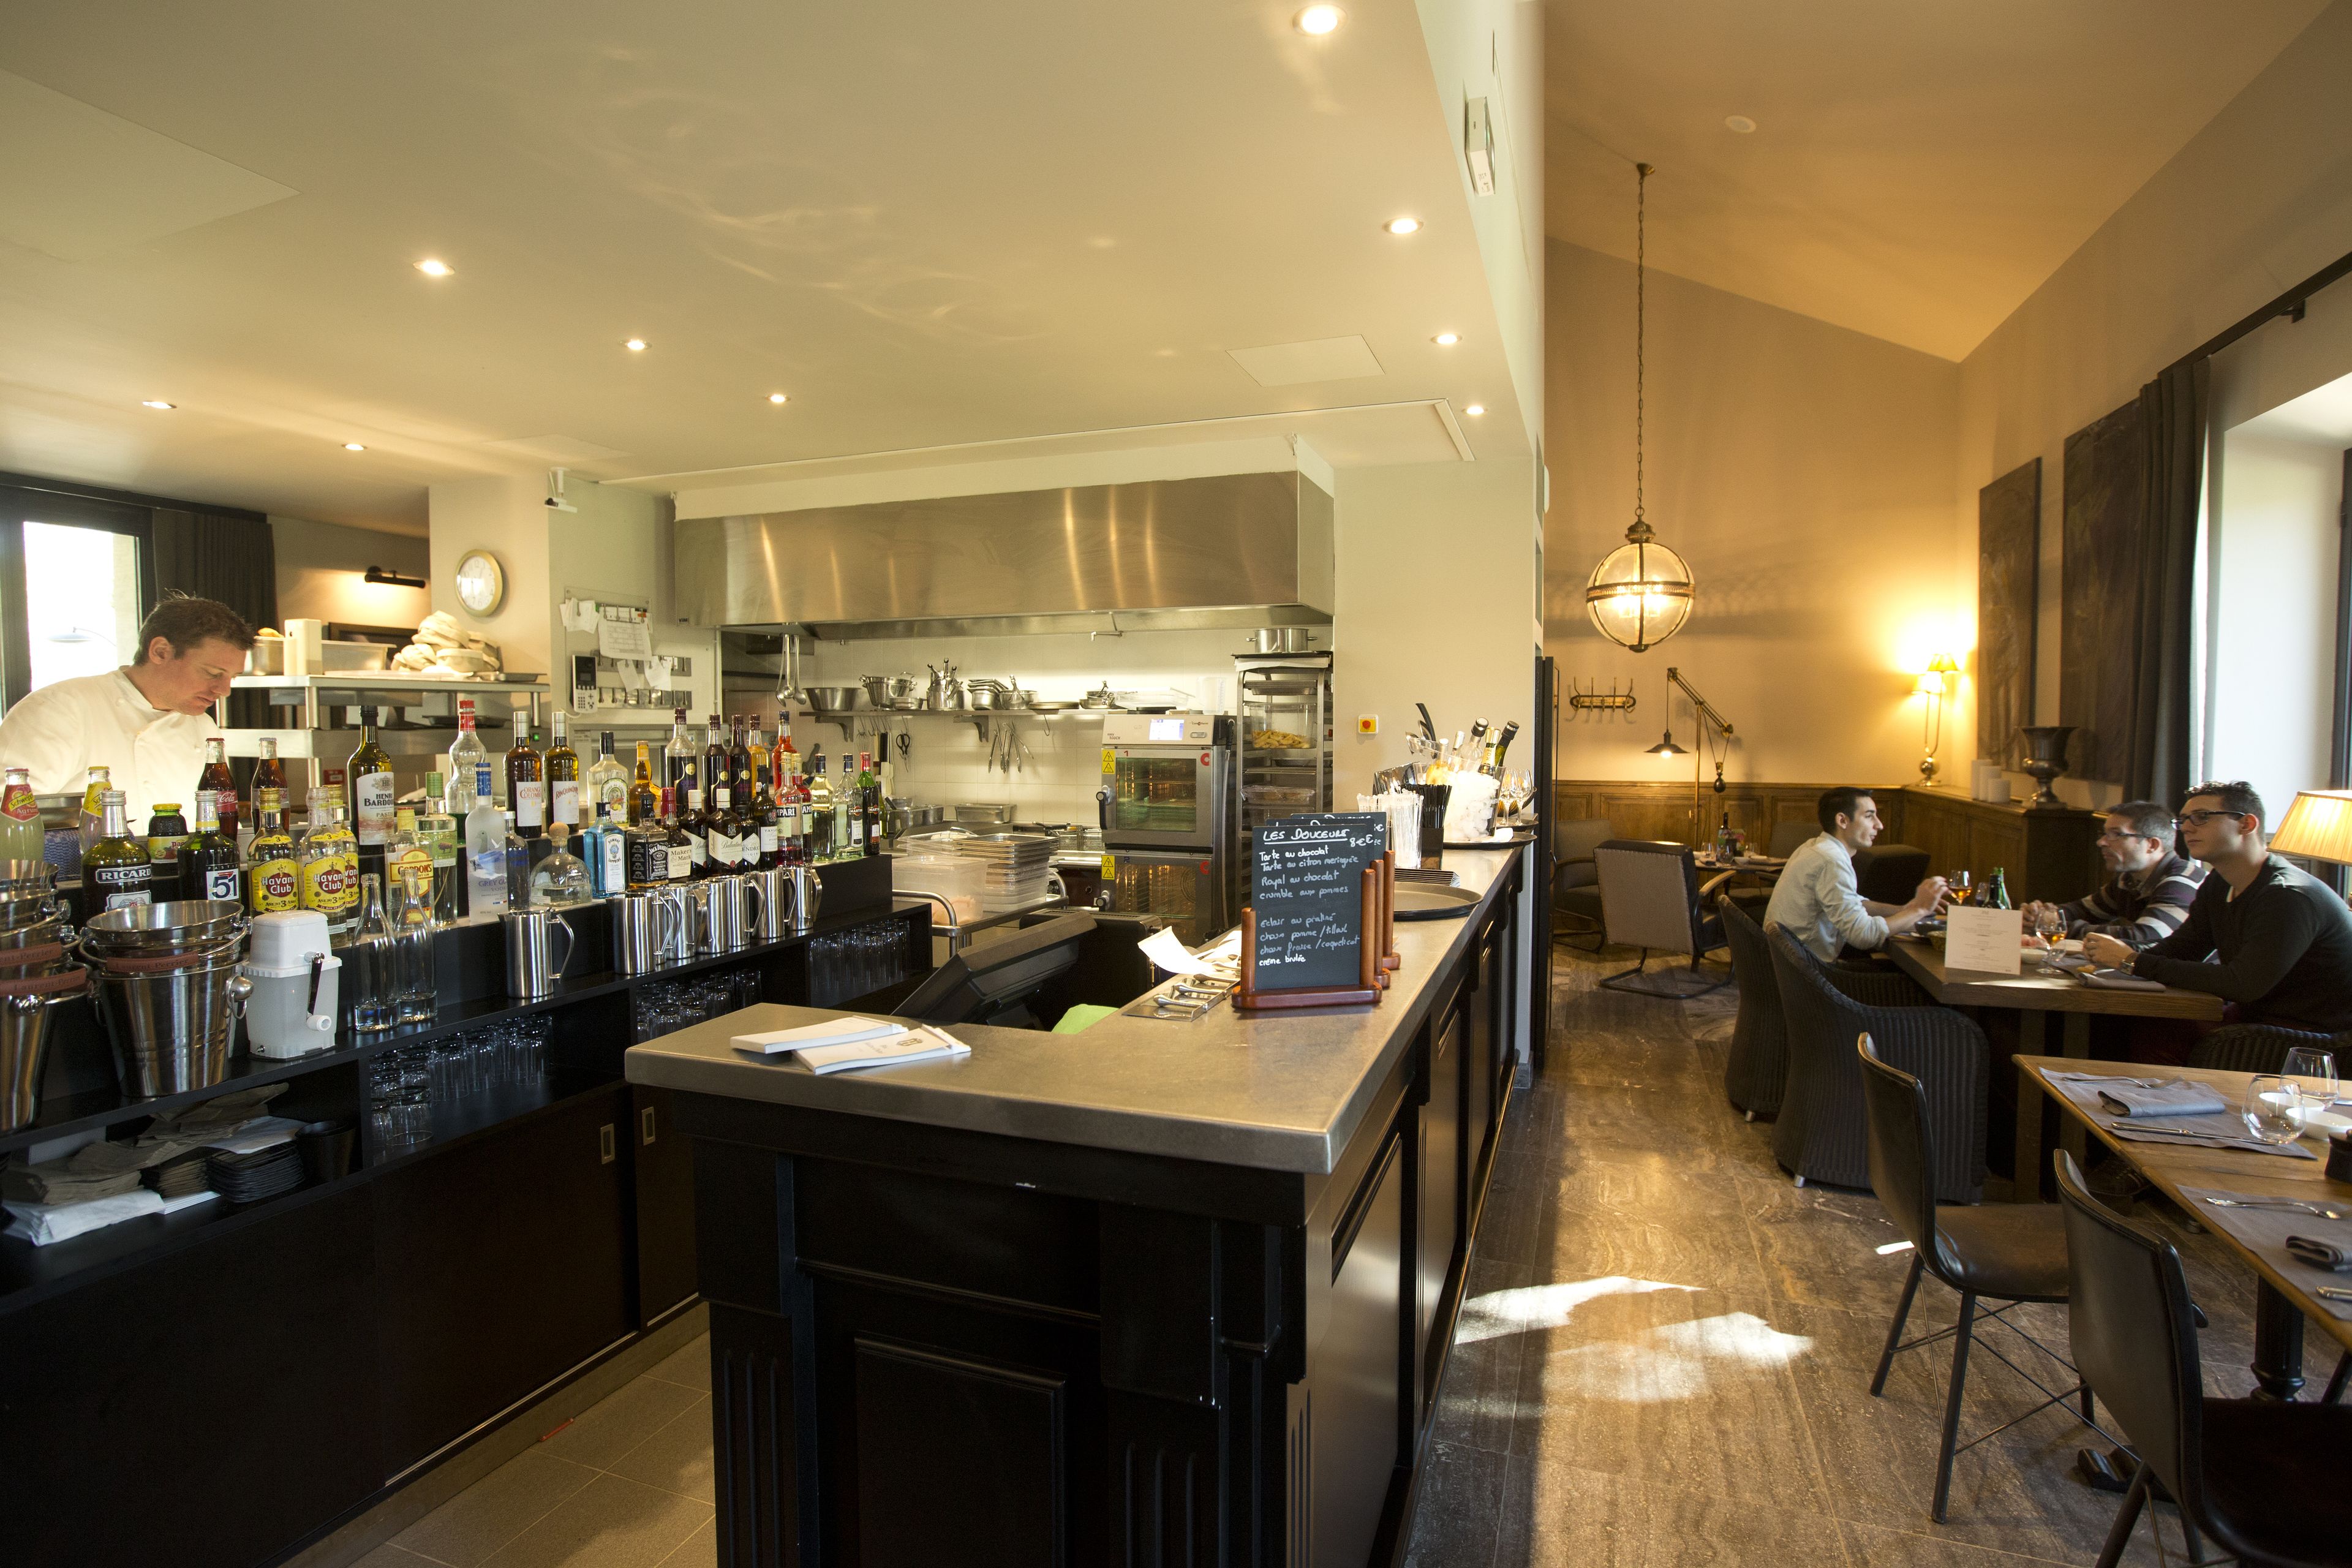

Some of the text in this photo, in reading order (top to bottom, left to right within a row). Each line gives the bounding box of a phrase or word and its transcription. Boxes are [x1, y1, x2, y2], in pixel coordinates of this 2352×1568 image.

[9, 791, 34, 808] Schwepp
[519, 790, 542, 799] COLOMB
[1263, 830, 1286, 842] LES
[649, 846, 658, 855] JACK
[1259, 849, 1280, 861] Tarte
[1297, 845, 1329, 858] chocolat
[1261, 860, 1282, 872] Tarte
[1298, 856, 1322, 867] citron
[101, 868, 151, 881] RICARD
[345, 876, 357, 885] lub
[1261, 873, 1286, 890] Royal
[1303, 869, 1340, 882] chocolat
[211, 873, 238, 899] 51
[262, 876, 296, 886] Havana
[322, 881, 342, 891] Club
[270, 885, 292, 894] Club
[1259, 889, 1294, 900] crumble
[1319, 886, 1349, 899] pommes
[1291, 930, 1317, 941] pomme
